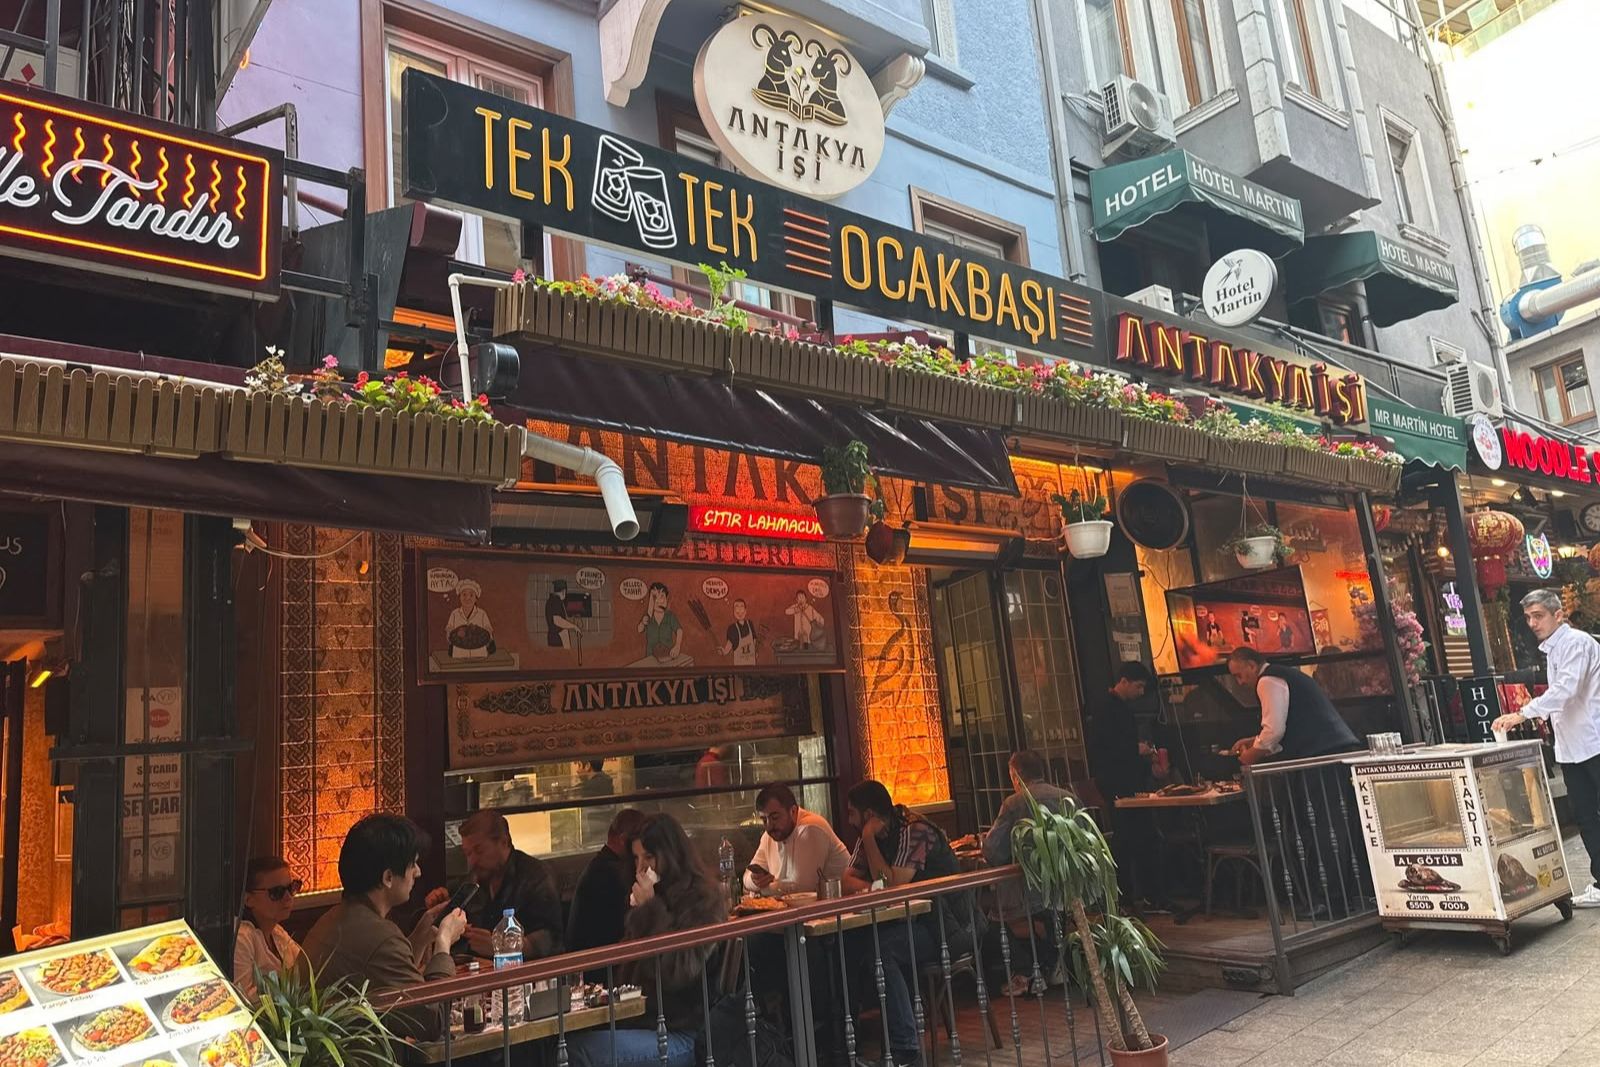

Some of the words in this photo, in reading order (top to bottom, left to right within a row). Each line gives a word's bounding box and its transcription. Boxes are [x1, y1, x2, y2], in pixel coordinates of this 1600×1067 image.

[475, 106, 574, 212] TEK
[727, 106, 867, 170] ANTAKYA
[777, 145, 822, 182] İŞİ
[51, 158, 241, 249] Tandır
[678, 172, 758, 263] TEK
[1104, 163, 1182, 217] HOTEL
[1191, 162, 1241, 201] HOTEL
[1242, 185, 1297, 223] MARTIN
[840, 224, 1057, 345] OCAKBAŞI
[1215, 276, 1255, 303] Hotel
[1379, 240, 1415, 269] HOTEL
[1416, 257, 1454, 283] MARTIN
[1210, 291, 1263, 320] Martin
[1116, 311, 1314, 411] ANTAKYA
[1310, 361, 1366, 427] İŞİ
[1374, 408, 1391, 425] MR
[1392, 413, 1428, 435] MARTİN
[1429, 422, 1459, 441] HOTEL
[1501, 426, 1592, 484] NOODLE
[560, 678, 700, 713] ANTAKYA
[706, 674, 737, 706] İŞİ
[1357, 766, 1387, 775] ANTAKYA
[1397, 763, 1421, 772] SOKAK
[1459, 775, 1482, 847] TANDIR
[1398, 857, 1413, 865] AL
[1416, 855, 1459, 865] GÖTÜR
